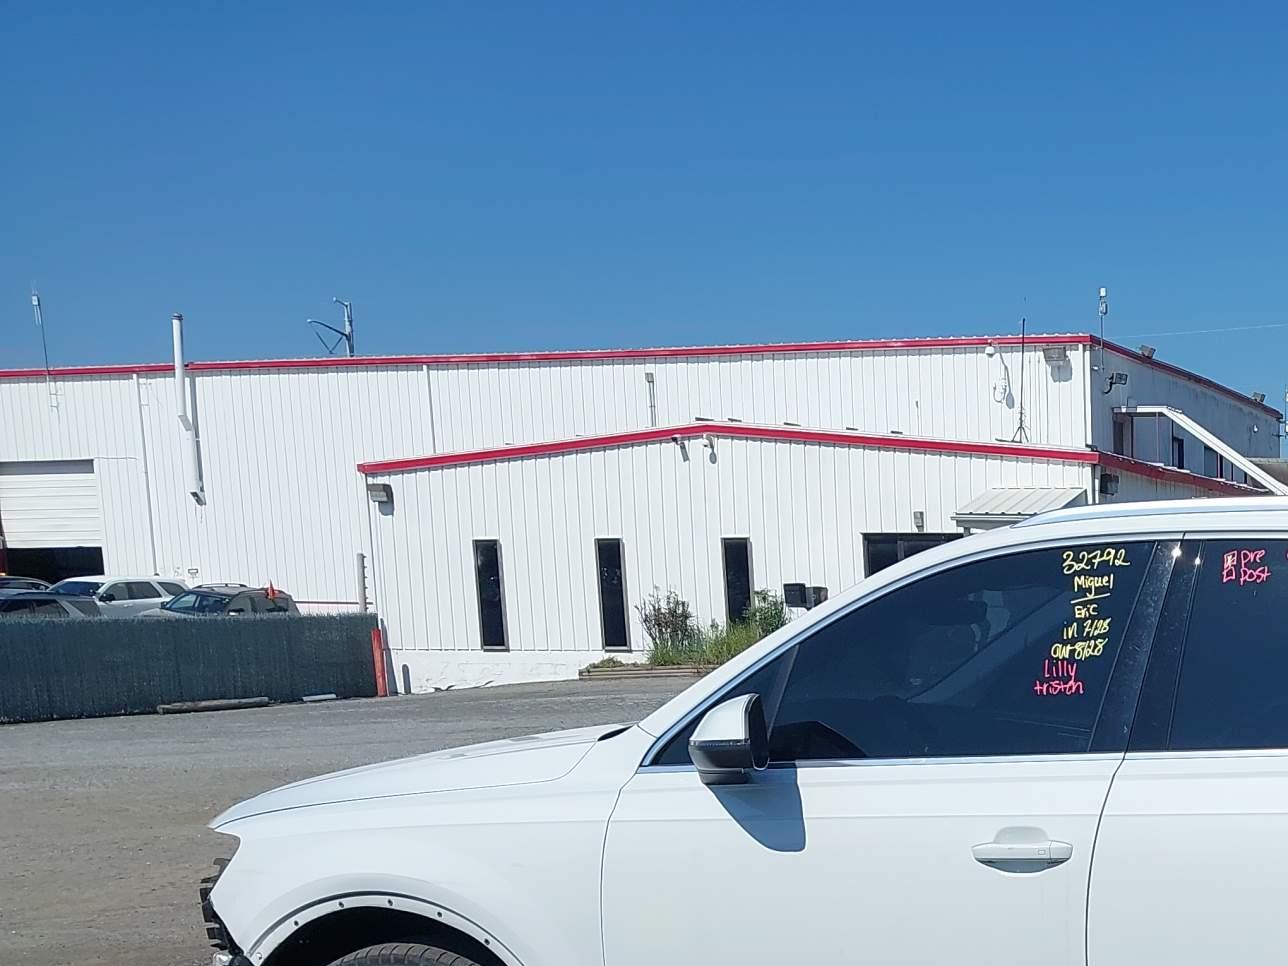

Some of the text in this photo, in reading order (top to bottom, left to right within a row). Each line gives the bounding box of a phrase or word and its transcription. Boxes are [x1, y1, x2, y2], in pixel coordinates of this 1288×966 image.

[1062, 547, 1131, 575] 32792
[1073, 573, 1114, 599] Miguel
[1063, 620, 1078, 640] in
